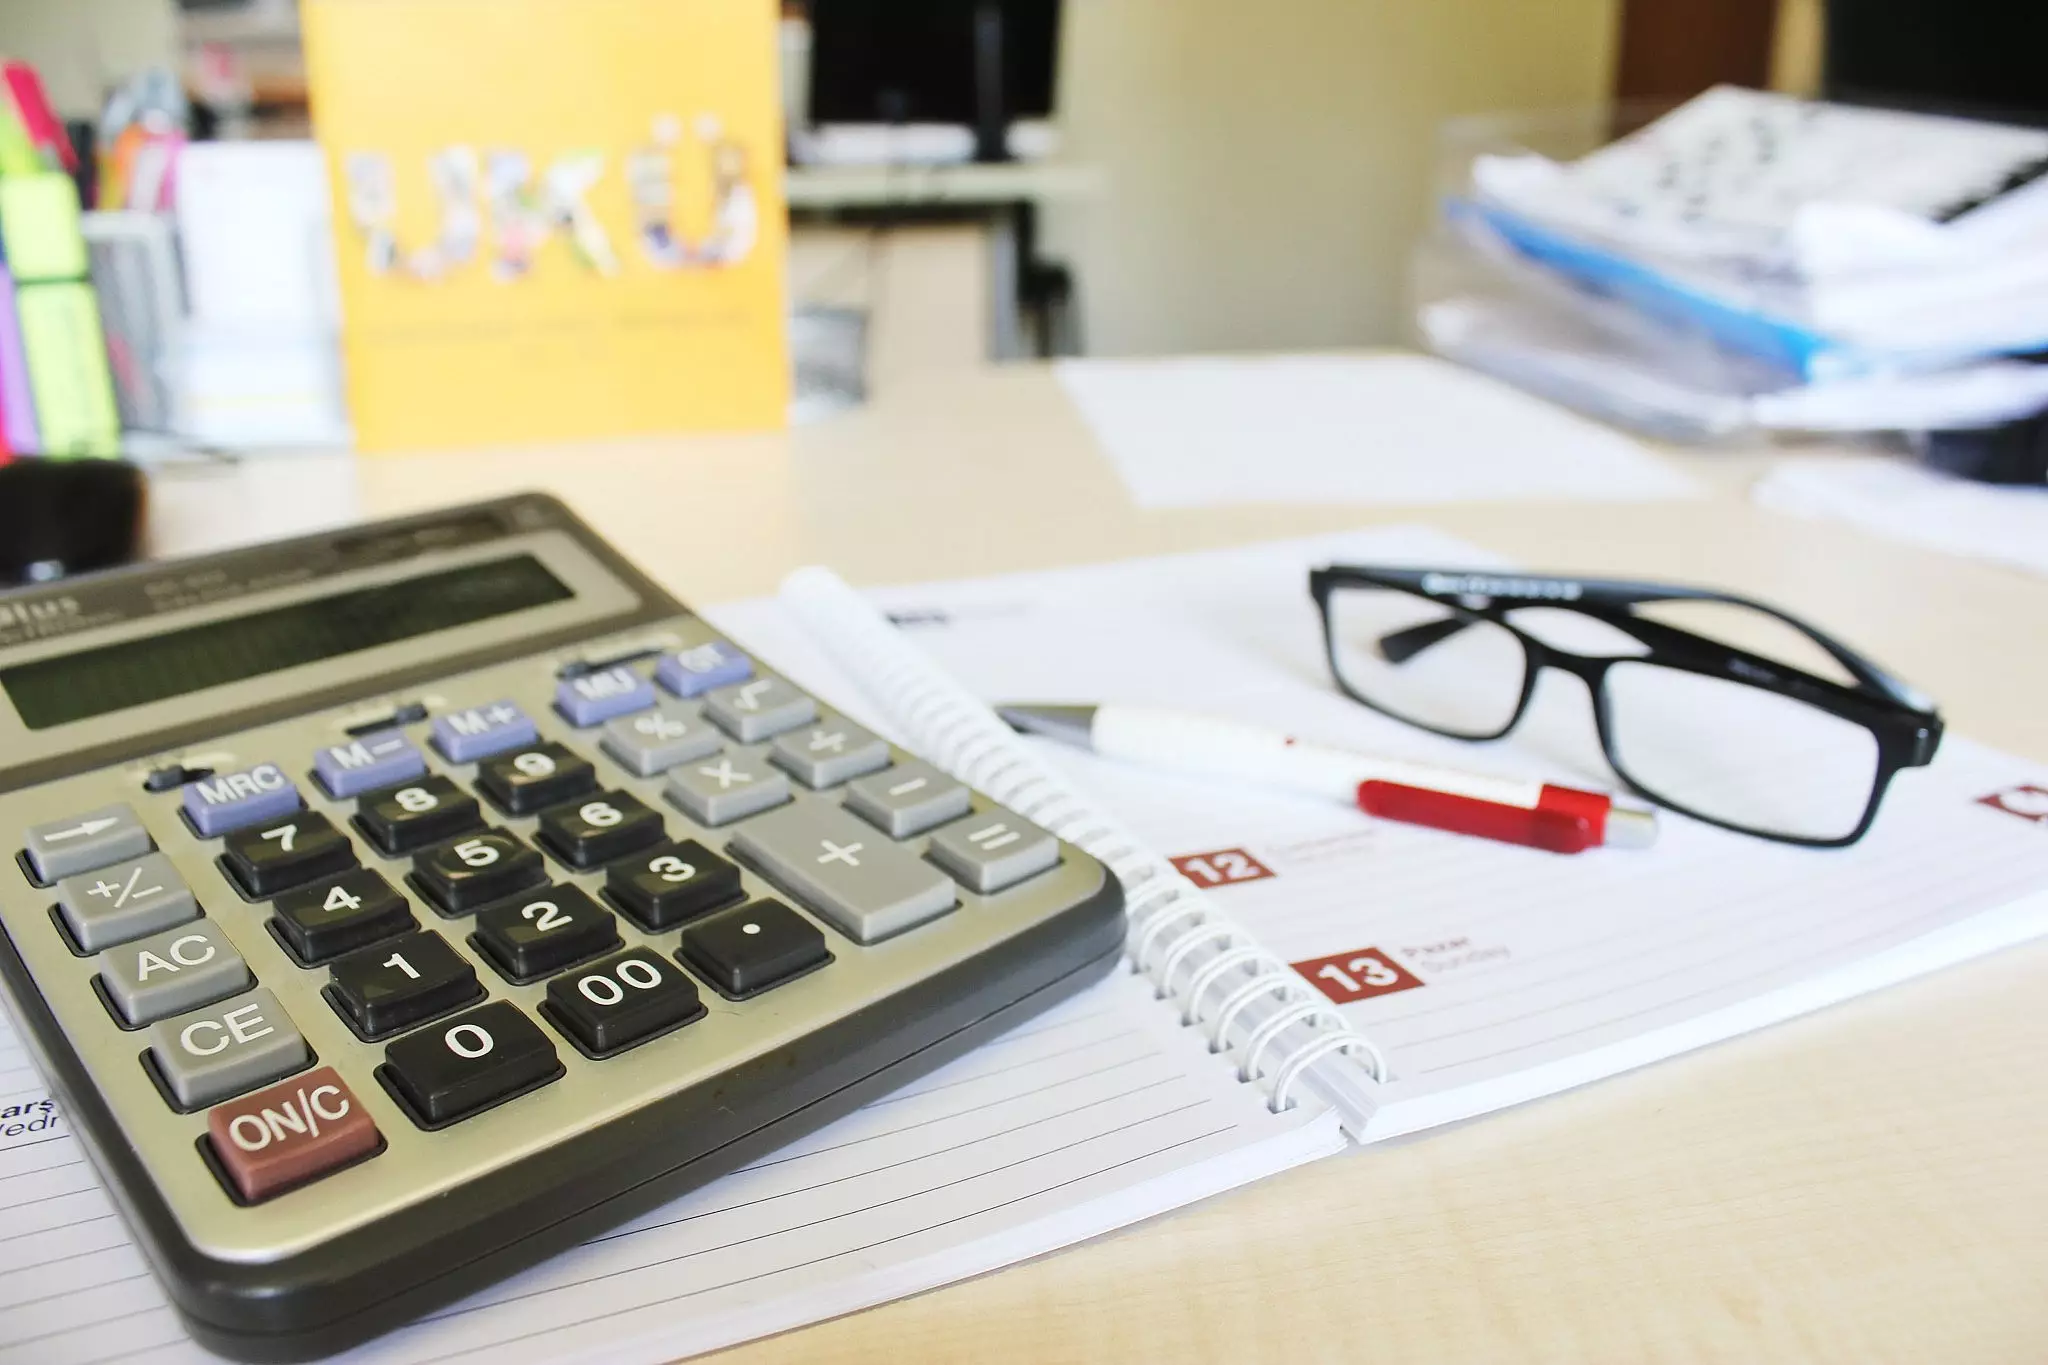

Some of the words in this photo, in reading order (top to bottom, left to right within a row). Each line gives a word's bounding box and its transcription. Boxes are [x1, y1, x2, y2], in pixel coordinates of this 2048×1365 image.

[346, 114, 757, 283] UKÜ
[574, 667, 636, 700] MU
[448, 704, 516, 735] M+
[513, 752, 556, 777] 9
[195, 765, 285, 804] MRC
[394, 787, 439, 812] 8
[579, 802, 623, 827] 6
[261, 824, 298, 852] 7
[454, 839, 500, 867] 5
[648, 855, 697, 883] 3
[1184, 851, 1261, 886] 12
[322, 885, 362, 912] 4
[521, 901, 573, 932] 2
[138, 934, 217, 981] AC
[382, 952, 421, 980] 1
[576, 958, 663, 1006] 00
[1317, 957, 1400, 993] 13
[180, 1003, 275, 1057] CE
[444, 1023, 494, 1059] 0
[228, 1084, 350, 1152] ON/C
